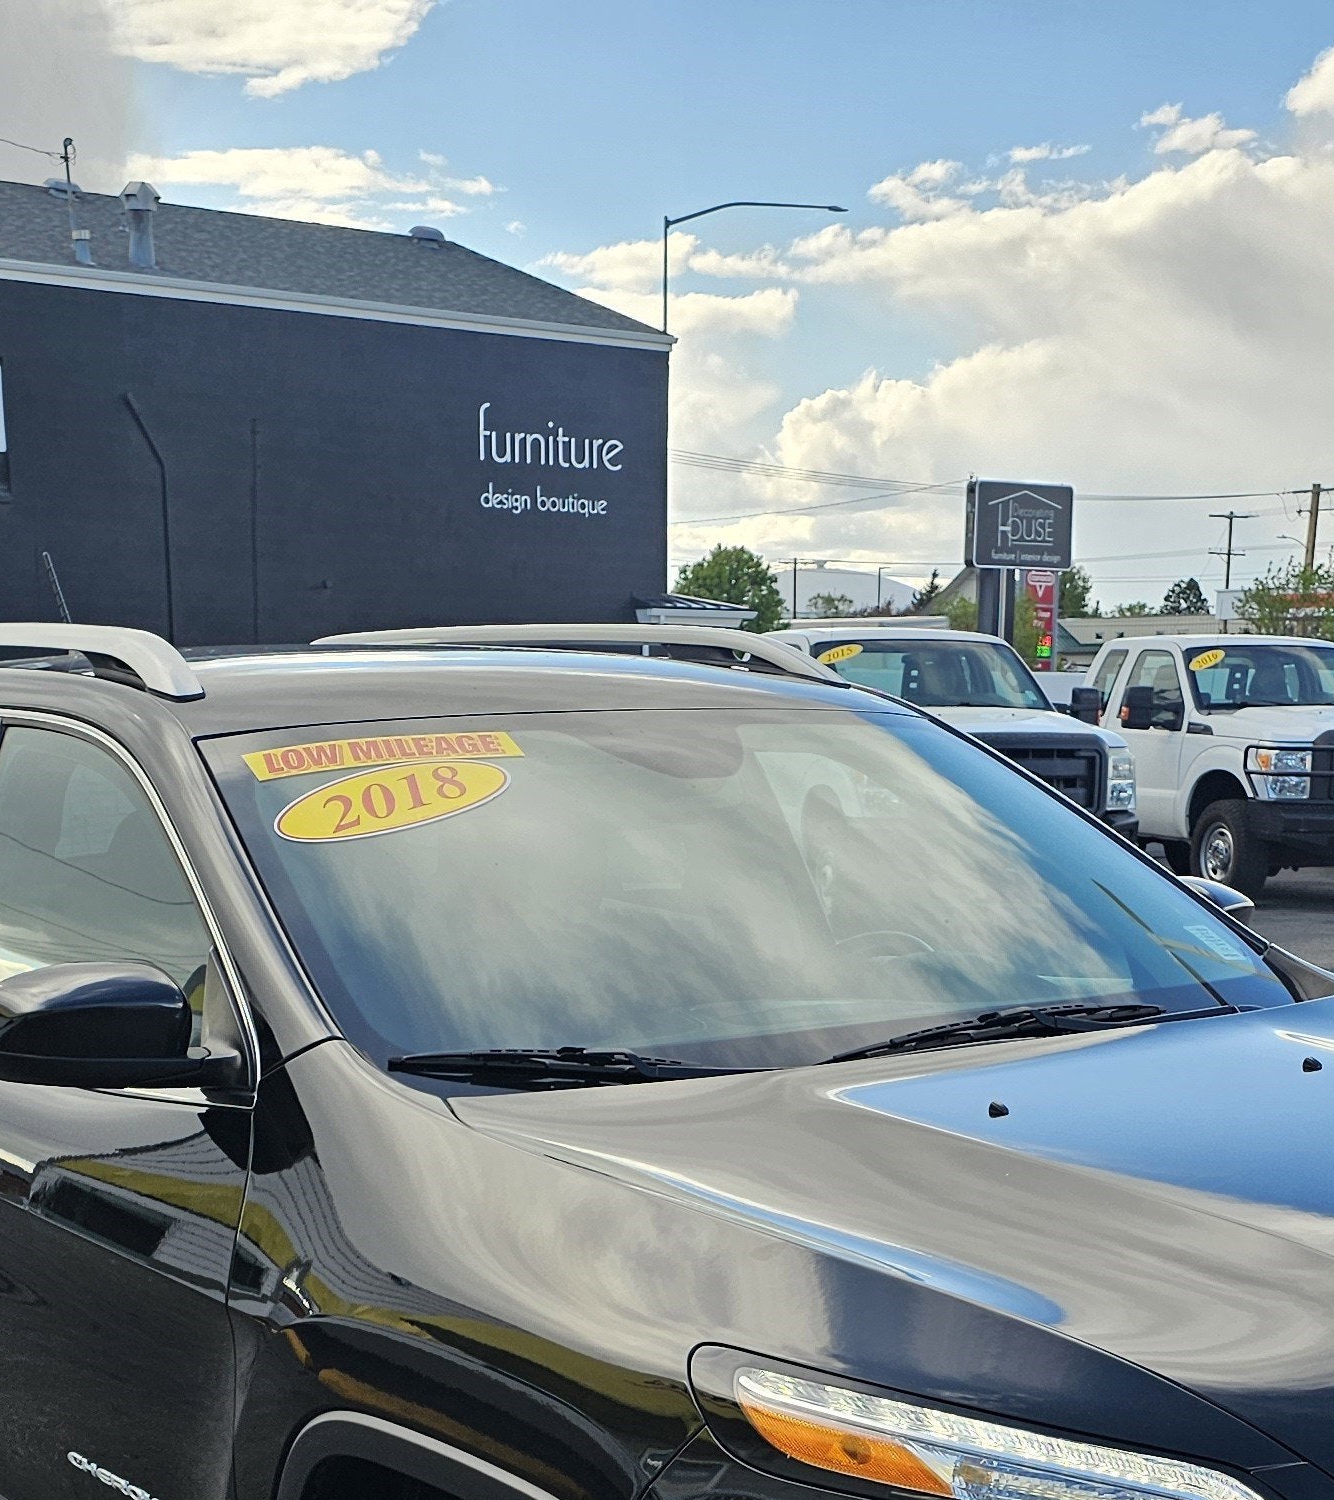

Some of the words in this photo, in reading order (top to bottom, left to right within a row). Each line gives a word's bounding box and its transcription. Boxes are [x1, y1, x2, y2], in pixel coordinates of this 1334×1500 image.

[479, 402, 624, 471] furniture
[480, 482, 531, 514] design
[536, 485, 608, 518] boutique
[826, 646, 853, 662] 2015
[1196, 652, 1218, 668] 2016
[263, 746, 344, 774] LOW
[346, 734, 506, 765] MILEAGE
[323, 766, 467, 834] 2018
